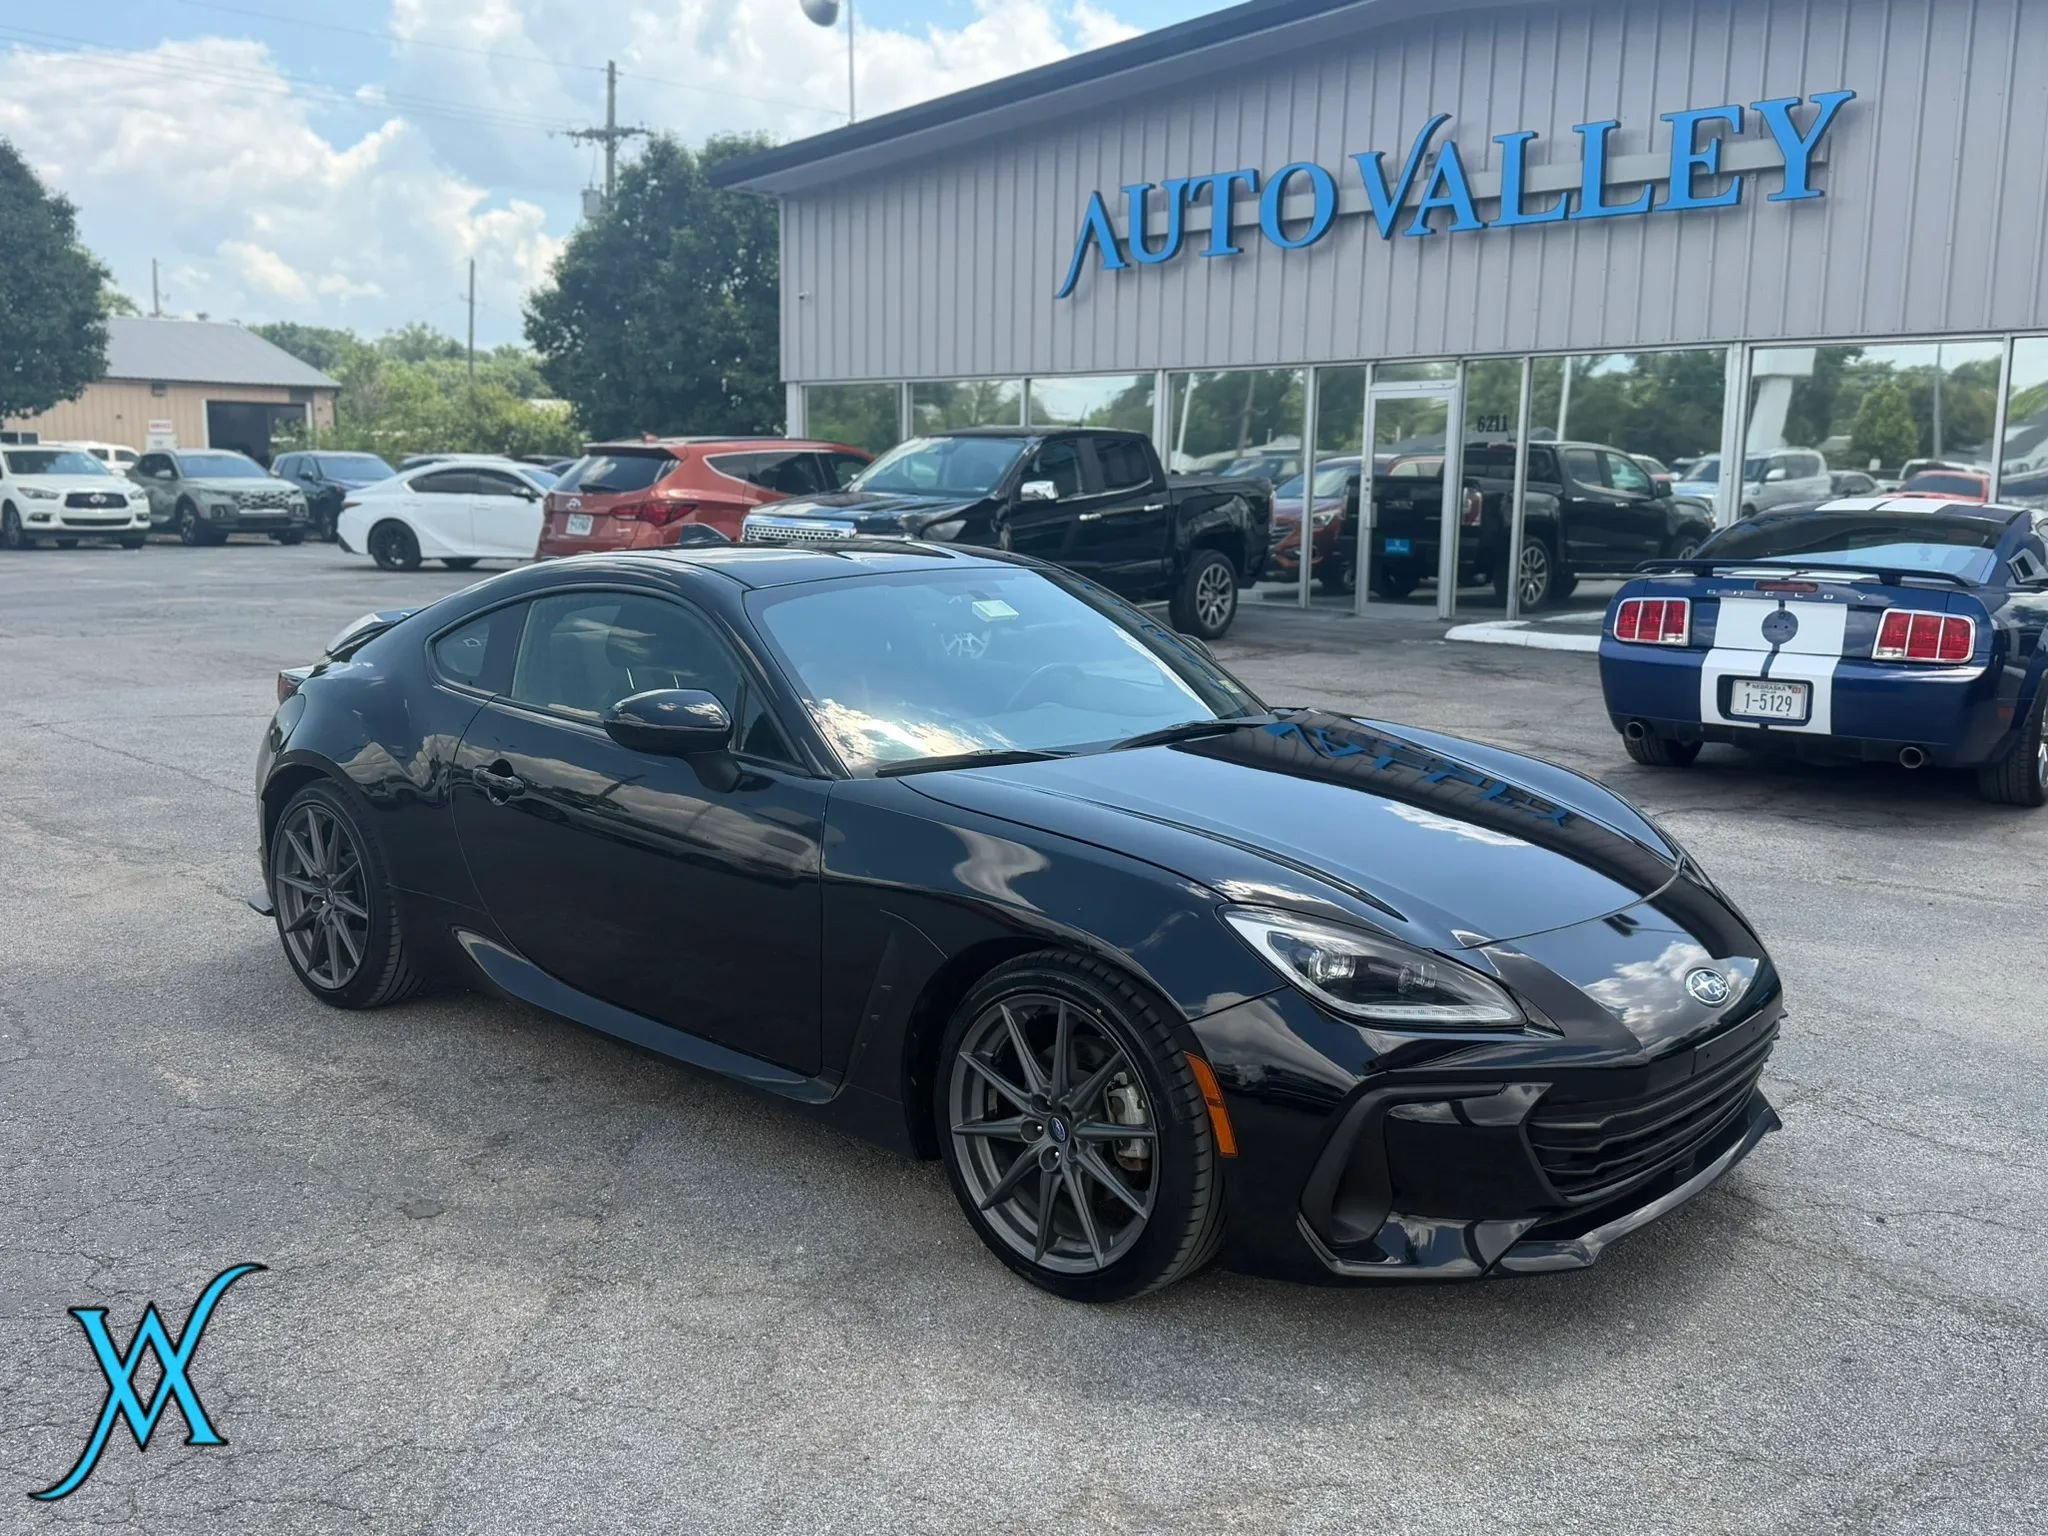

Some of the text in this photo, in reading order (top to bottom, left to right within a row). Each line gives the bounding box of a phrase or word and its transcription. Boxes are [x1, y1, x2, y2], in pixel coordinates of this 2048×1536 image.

[1055, 89, 1856, 299] AUTO VALLEY
[1477, 415, 1508, 432] 6211
[1744, 692, 1793, 713] 1-5129
